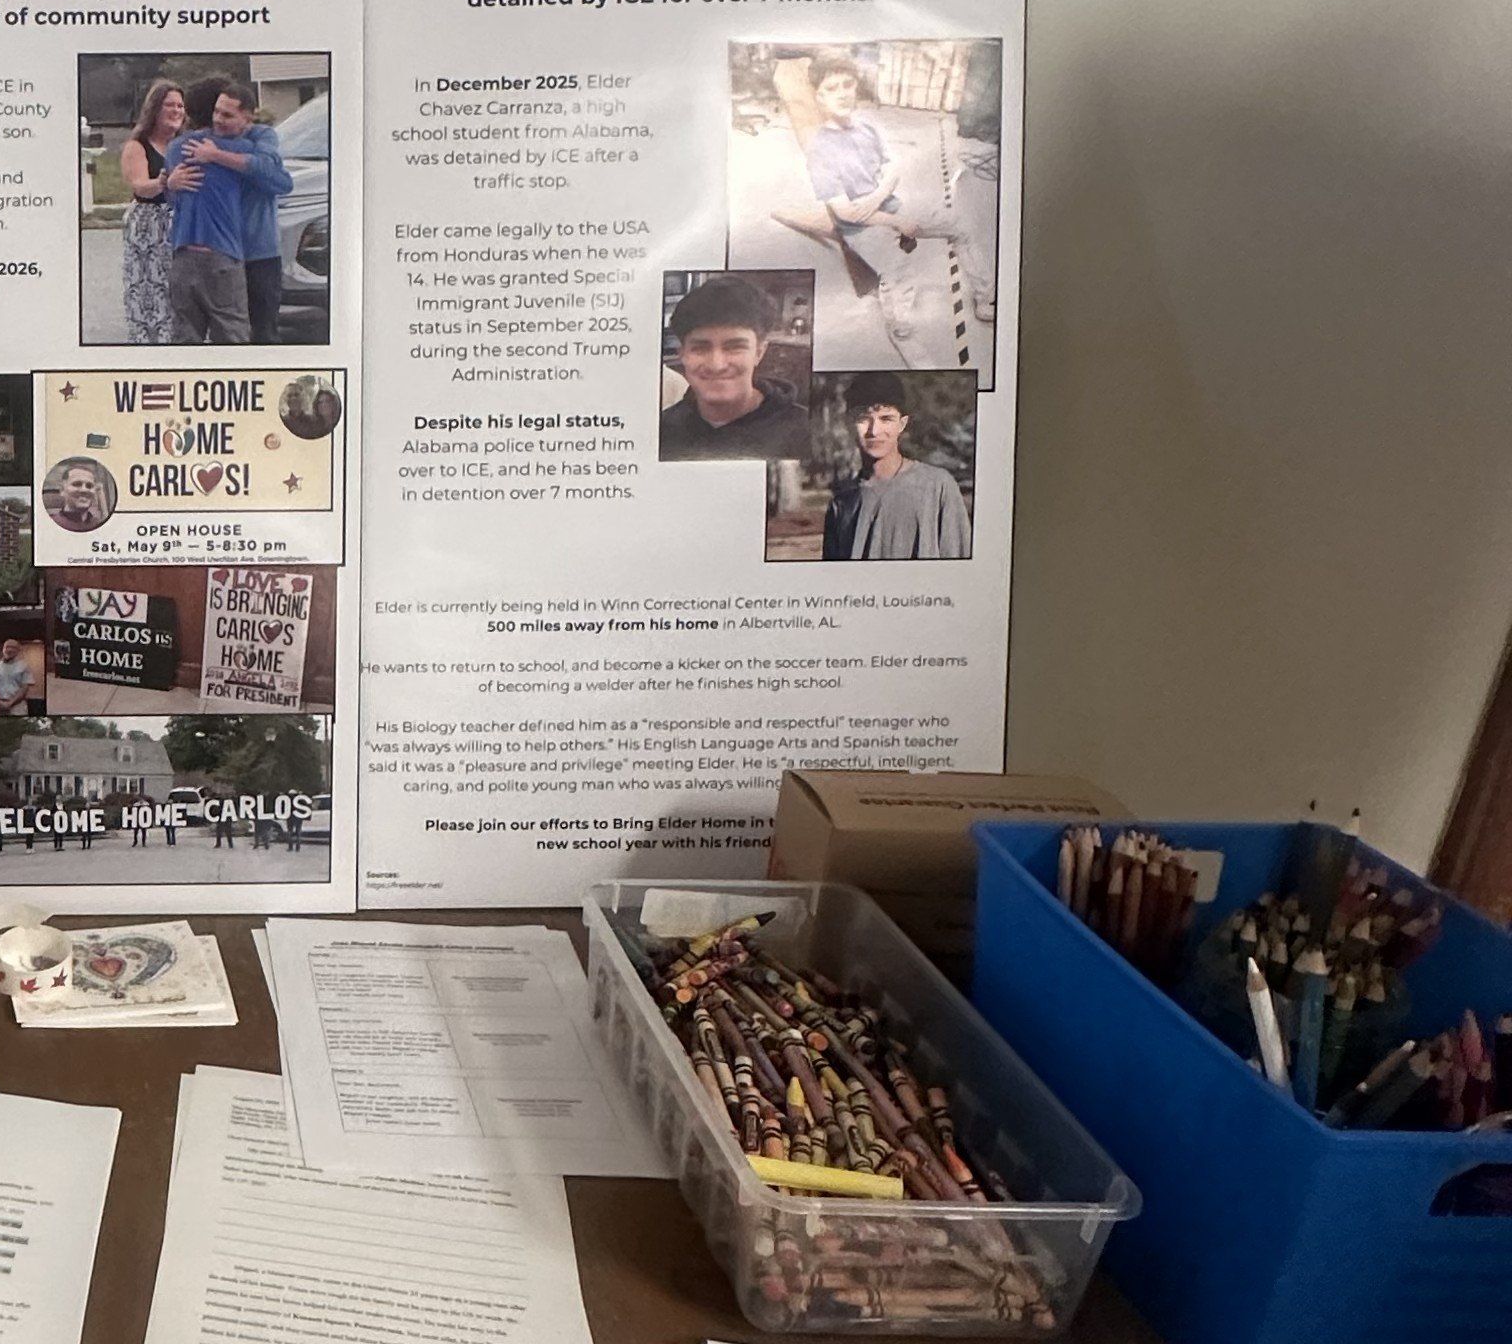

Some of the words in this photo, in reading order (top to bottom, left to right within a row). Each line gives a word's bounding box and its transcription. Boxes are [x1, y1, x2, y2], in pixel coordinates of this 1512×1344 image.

[4, 5, 29, 26] of
[33, 3, 171, 29] community
[176, 5, 271, 29] support
[414, 77, 430, 92] In
[435, 75, 532, 92] December
[586, 73, 630, 88] Elder
[413, 413, 483, 433] Despite
[487, 413, 513, 429] his
[517, 412, 561, 432] legal
[564, 413, 625, 429] status,
[136, 525, 181, 537] OPEN
[187, 524, 242, 537] HOUSE
[91, 541, 121, 555] Sat,
[128, 541, 157, 555] May
[206, 540, 257, 552] 5-8:30
[263, 541, 287, 554] pm
[233, 571, 286, 595] LOVE
[85, 590, 137, 619] YAY
[209, 587, 223, 609] IS
[74, 622, 151, 645] CARLOS
[486, 619, 516, 633] 500
[519, 618, 561, 632] miles
[563, 620, 605, 634] away
[607, 617, 645, 631] from
[649, 616, 671, 630] his
[674, 616, 719, 630] home
[722, 619, 736, 629] in
[81, 648, 143, 670] HOME
[206, 684, 233, 698] FOR
[236, 686, 299, 707] PRESIDENT
[122, 803, 187, 829] HOME
[204, 794, 313, 823] CARLOS
